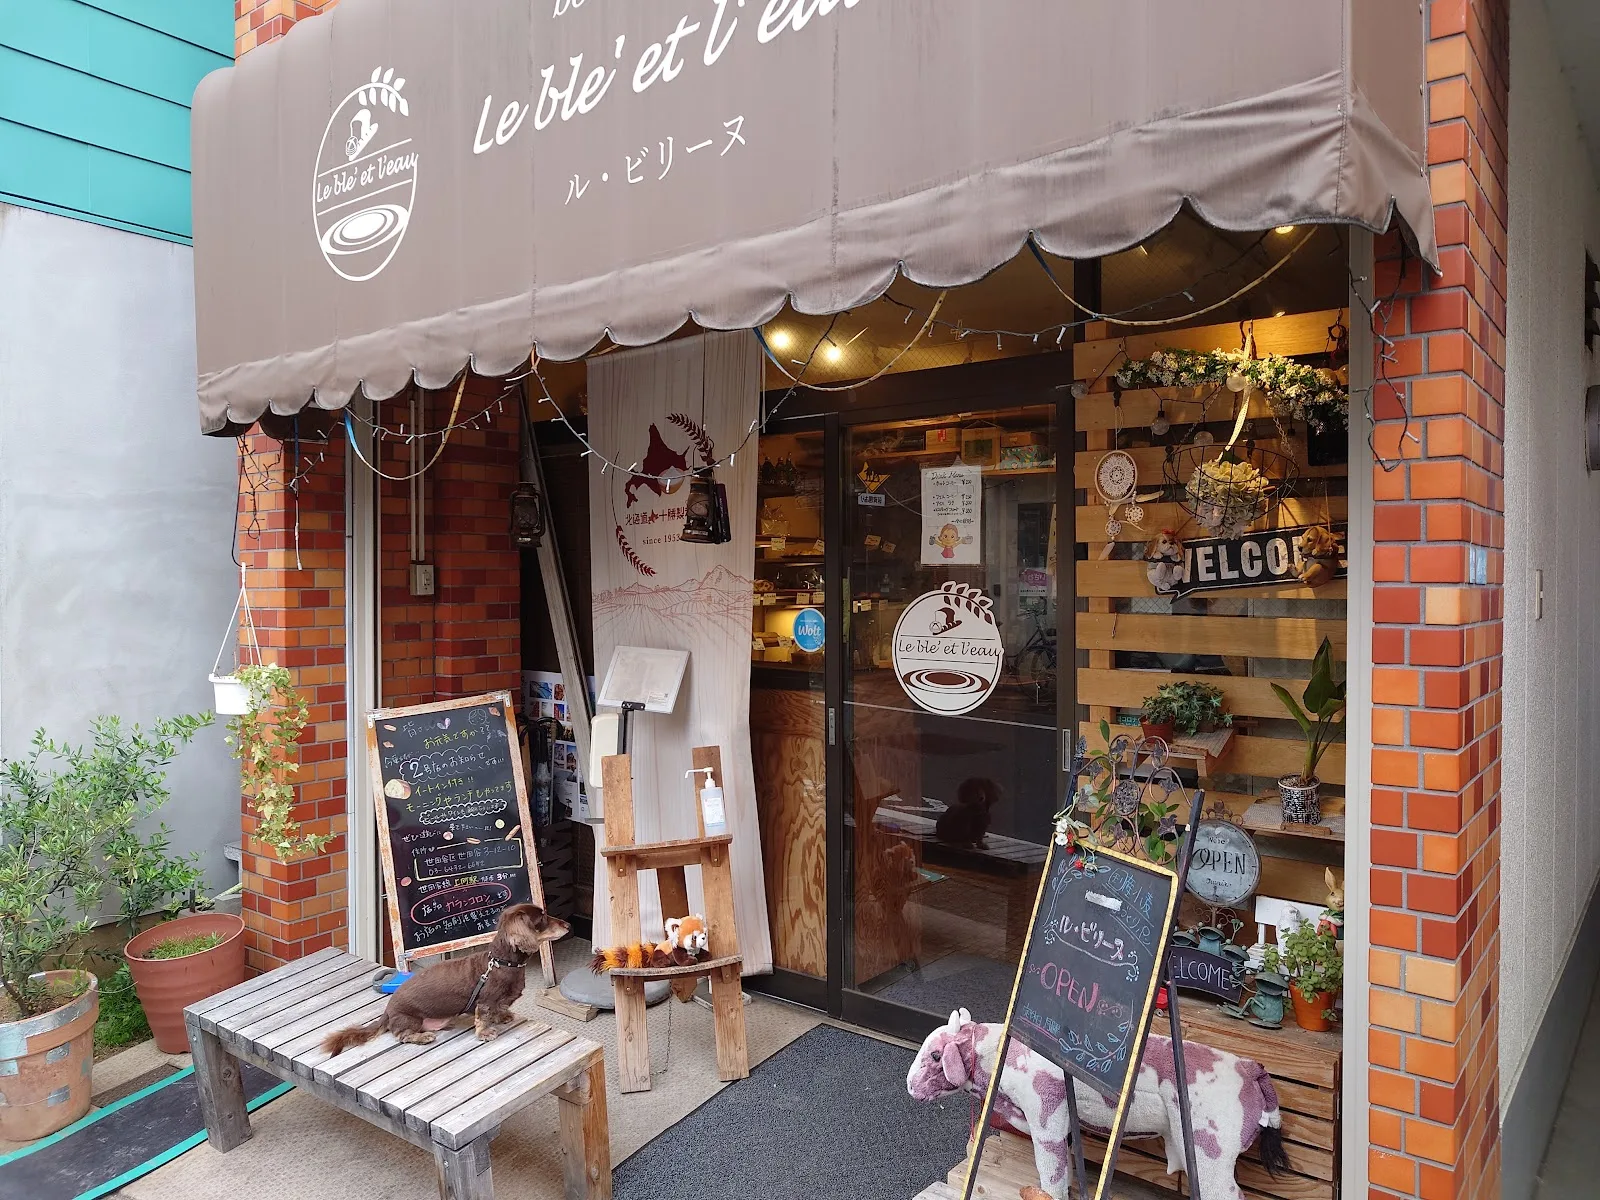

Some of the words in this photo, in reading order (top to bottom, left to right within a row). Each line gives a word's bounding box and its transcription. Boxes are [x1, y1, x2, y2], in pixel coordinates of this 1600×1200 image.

[473, 94, 529, 154] Le
[632, 14, 701, 93] et
[564, 114, 747, 206] ル・ビリーヌ
[316, 182, 333, 203] Le
[360, 163, 376, 187] et
[642, 536, 662, 545] since
[1182, 536, 1347, 584] ELCO
[798, 624, 822, 636] Wolt
[899, 639, 916, 653] Le
[943, 642, 958, 655] et
[960, 641, 1002, 658] l'eau
[1190, 848, 1246, 875] OPEN
[1040, 962, 1099, 1013] OPEN
[1173, 956, 1230, 991] LCOME
